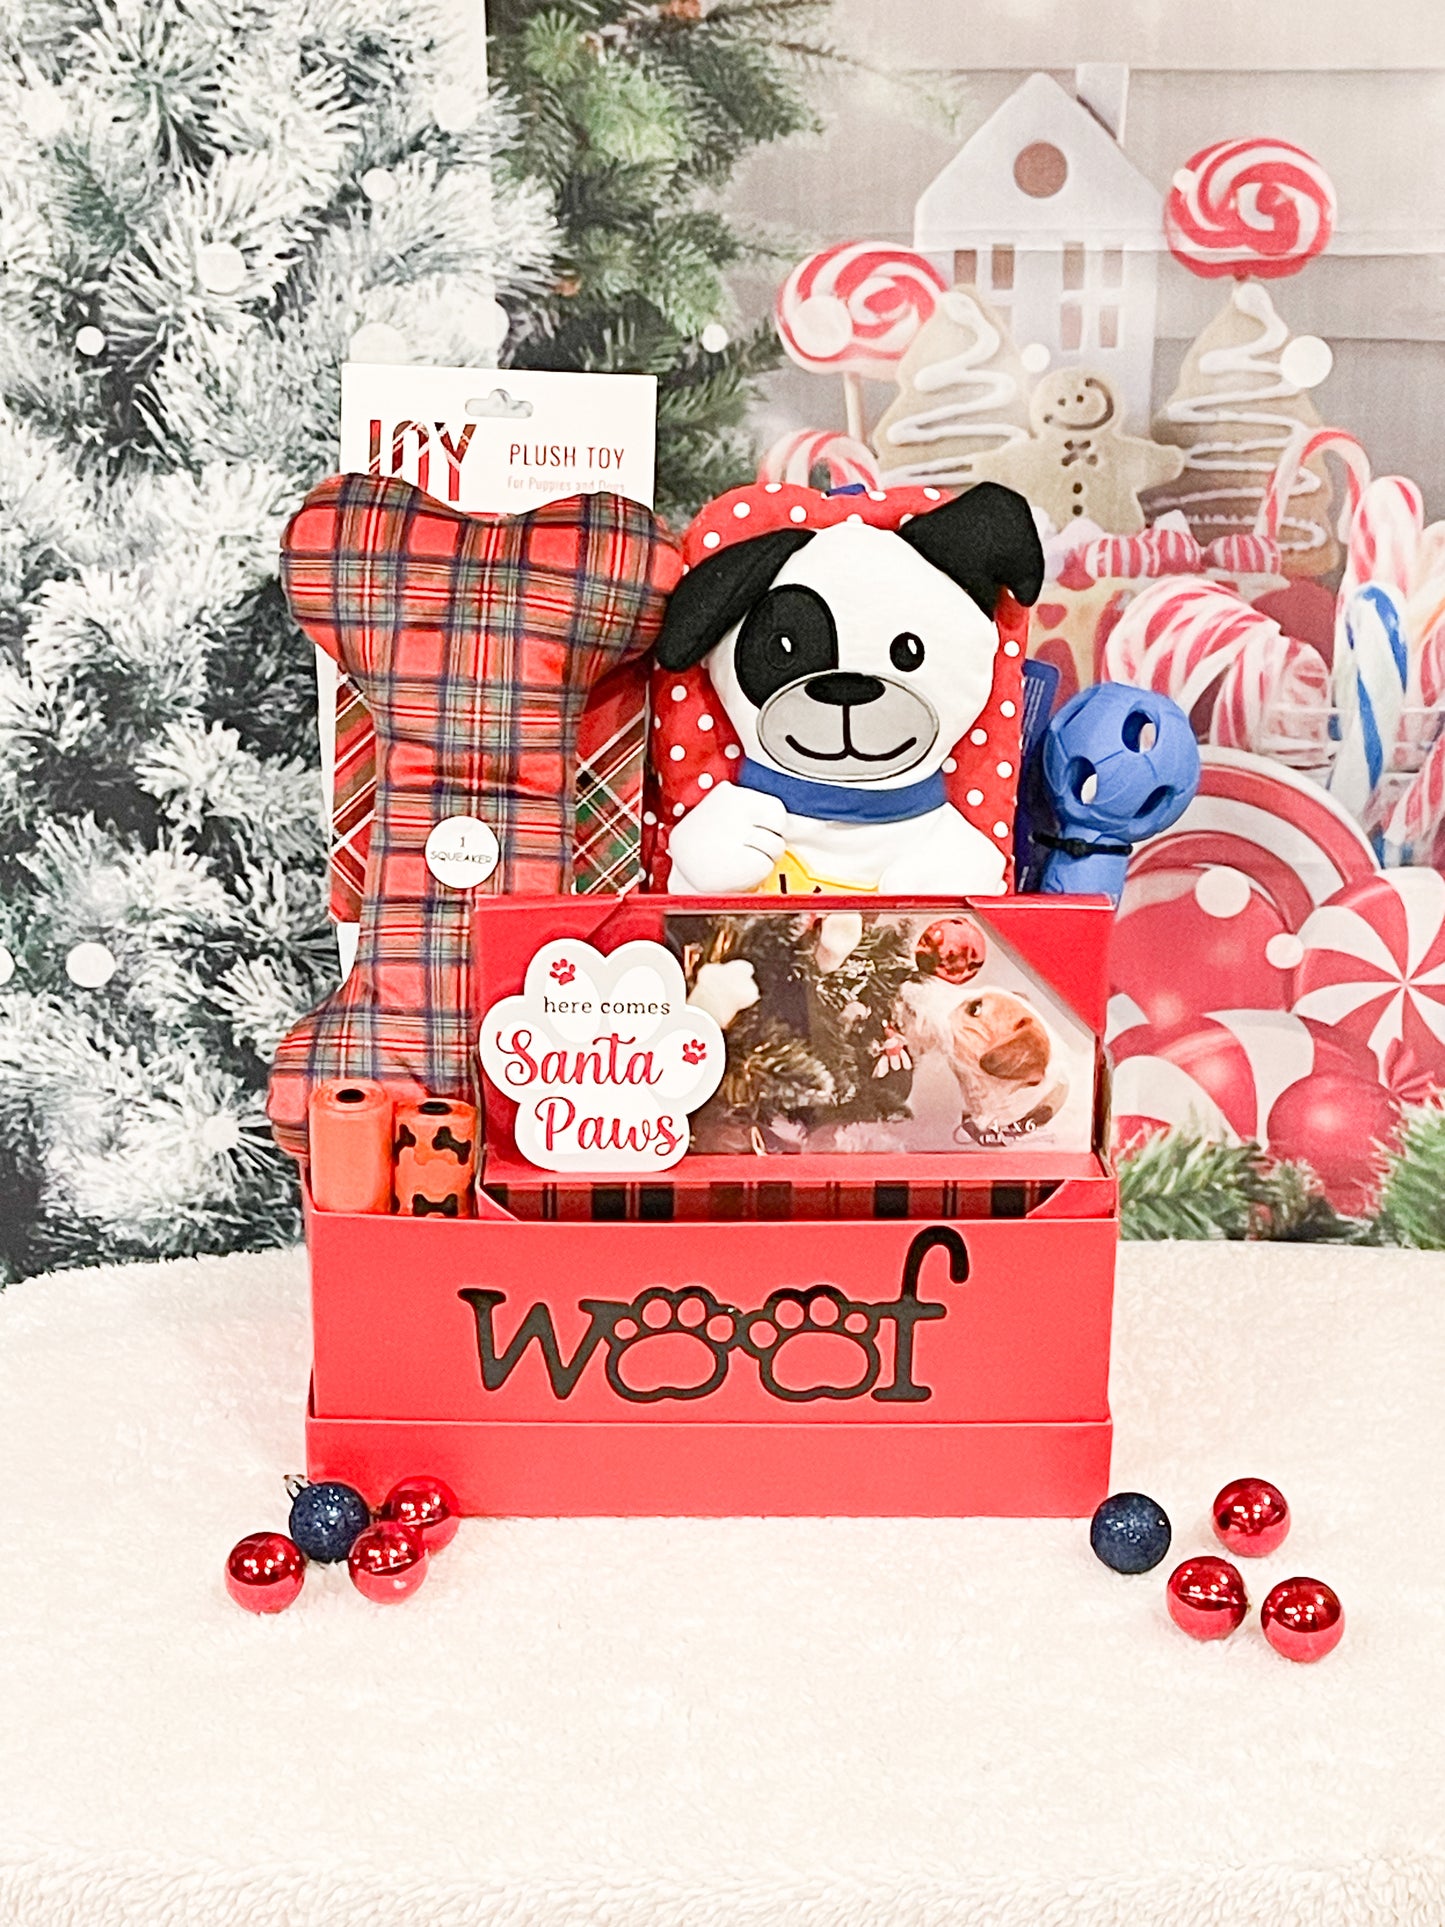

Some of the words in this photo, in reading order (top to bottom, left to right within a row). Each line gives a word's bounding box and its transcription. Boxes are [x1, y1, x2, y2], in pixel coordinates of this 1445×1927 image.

[509, 443, 577, 468] PLUSH
[587, 446, 625, 470] TOY
[507, 475, 524, 489] For
[528, 476, 571, 493] Puppies
[575, 480, 595, 491] and
[459, 835, 466, 848] 1
[430, 850, 492, 865] SQUEAKER
[543, 995, 593, 1015] here
[599, 1000, 671, 1016] comes
[496, 1028, 664, 1086] Santa
[534, 1095, 684, 1157] Paws
